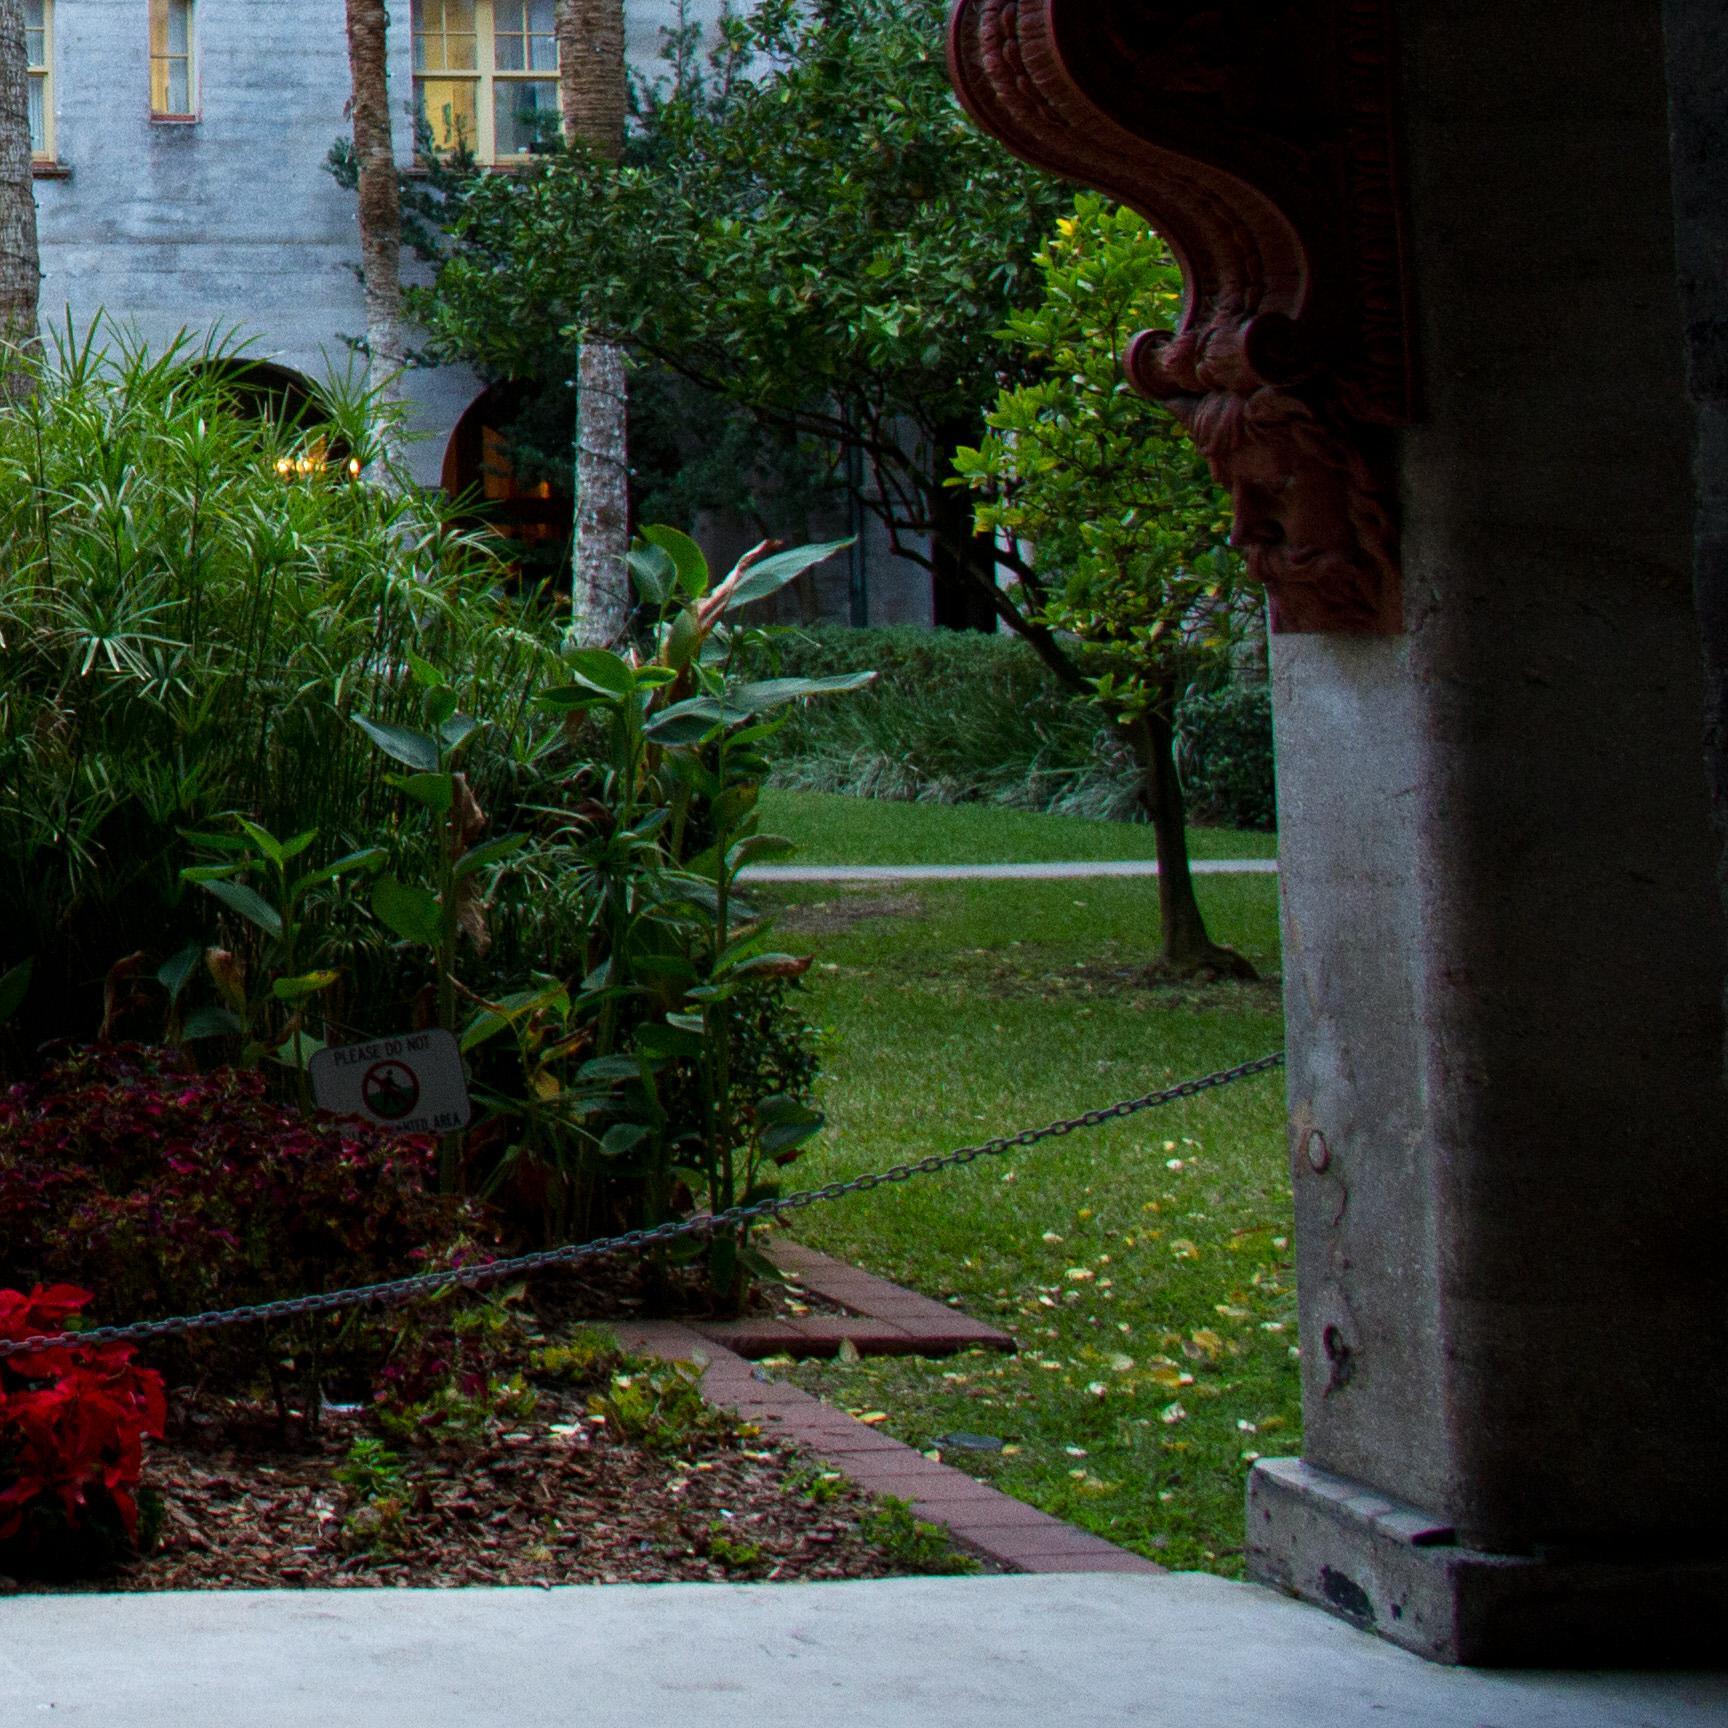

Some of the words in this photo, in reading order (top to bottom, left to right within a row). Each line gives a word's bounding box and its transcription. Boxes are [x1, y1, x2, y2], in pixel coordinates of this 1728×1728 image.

[334, 1044, 381, 1066] PLEASE
[385, 1040, 402, 1057] DO
[407, 1034, 431, 1052] NOT
[433, 1112, 461, 1129] AREA
